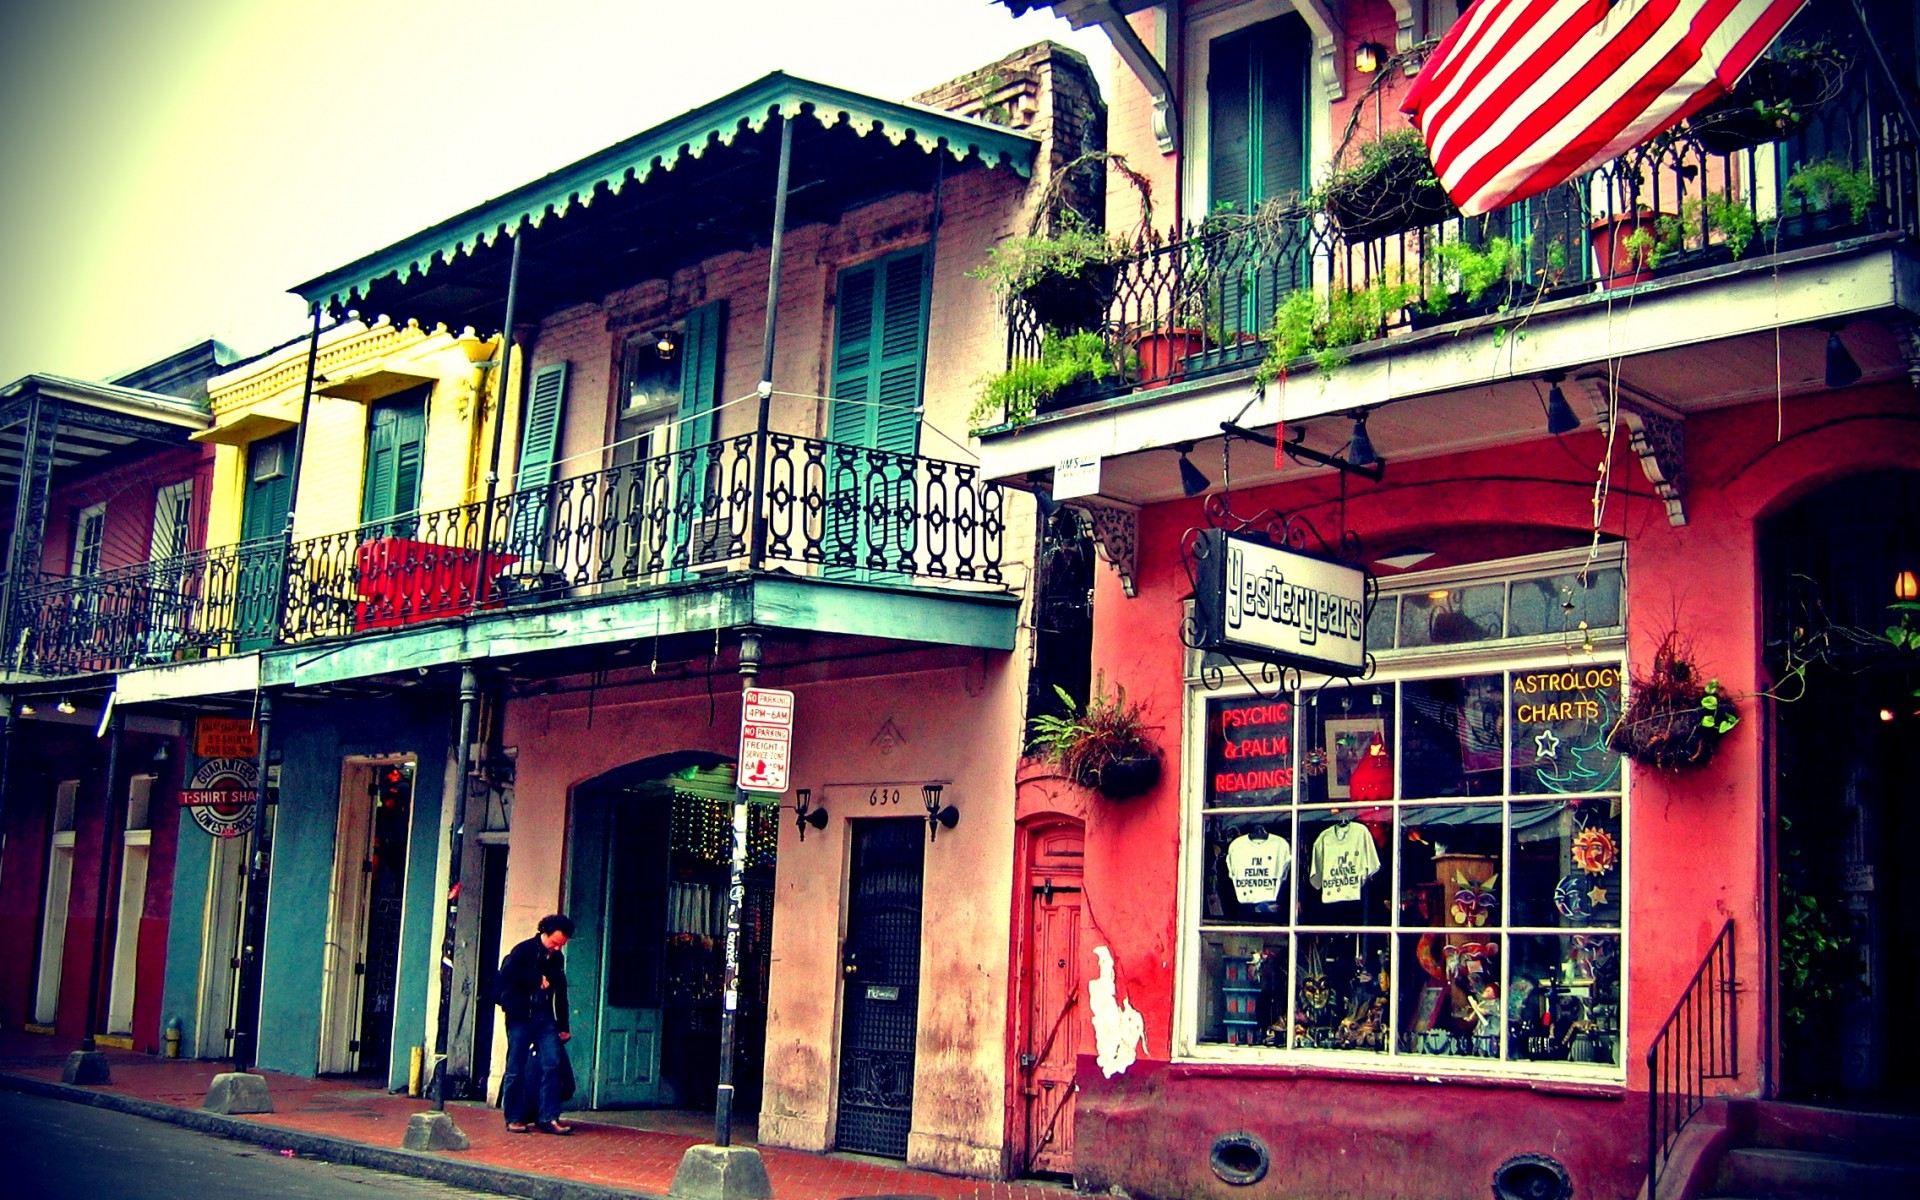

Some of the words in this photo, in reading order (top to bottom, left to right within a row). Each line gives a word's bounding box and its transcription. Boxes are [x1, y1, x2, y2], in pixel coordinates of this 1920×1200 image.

[1227, 547, 1362, 645] Yesteryears
[1514, 668, 1621, 694] ASTROLOGY
[760, 694, 788, 706] PARKING
[1222, 703, 1289, 728] PSYCHIC
[1518, 700, 1598, 723] CHARTS
[745, 727, 755, 736] NO
[757, 729, 786, 739] PARKING
[746, 741, 778, 751] FREIGHT
[1224, 741, 1237, 759] &
[1241, 736, 1288, 758] PALM
[197, 759, 257, 784] GUARANTEED
[1215, 767, 1294, 793] READINGS
[182, 791, 228, 804] T-SHIRT
[869, 788, 900, 805] 630
[196, 809, 230, 834] LOWEST
[1252, 857, 1262, 866] I'M
[1244, 868, 1269, 877] FELINE
[1236, 878, 1277, 888] DEPENDENT
